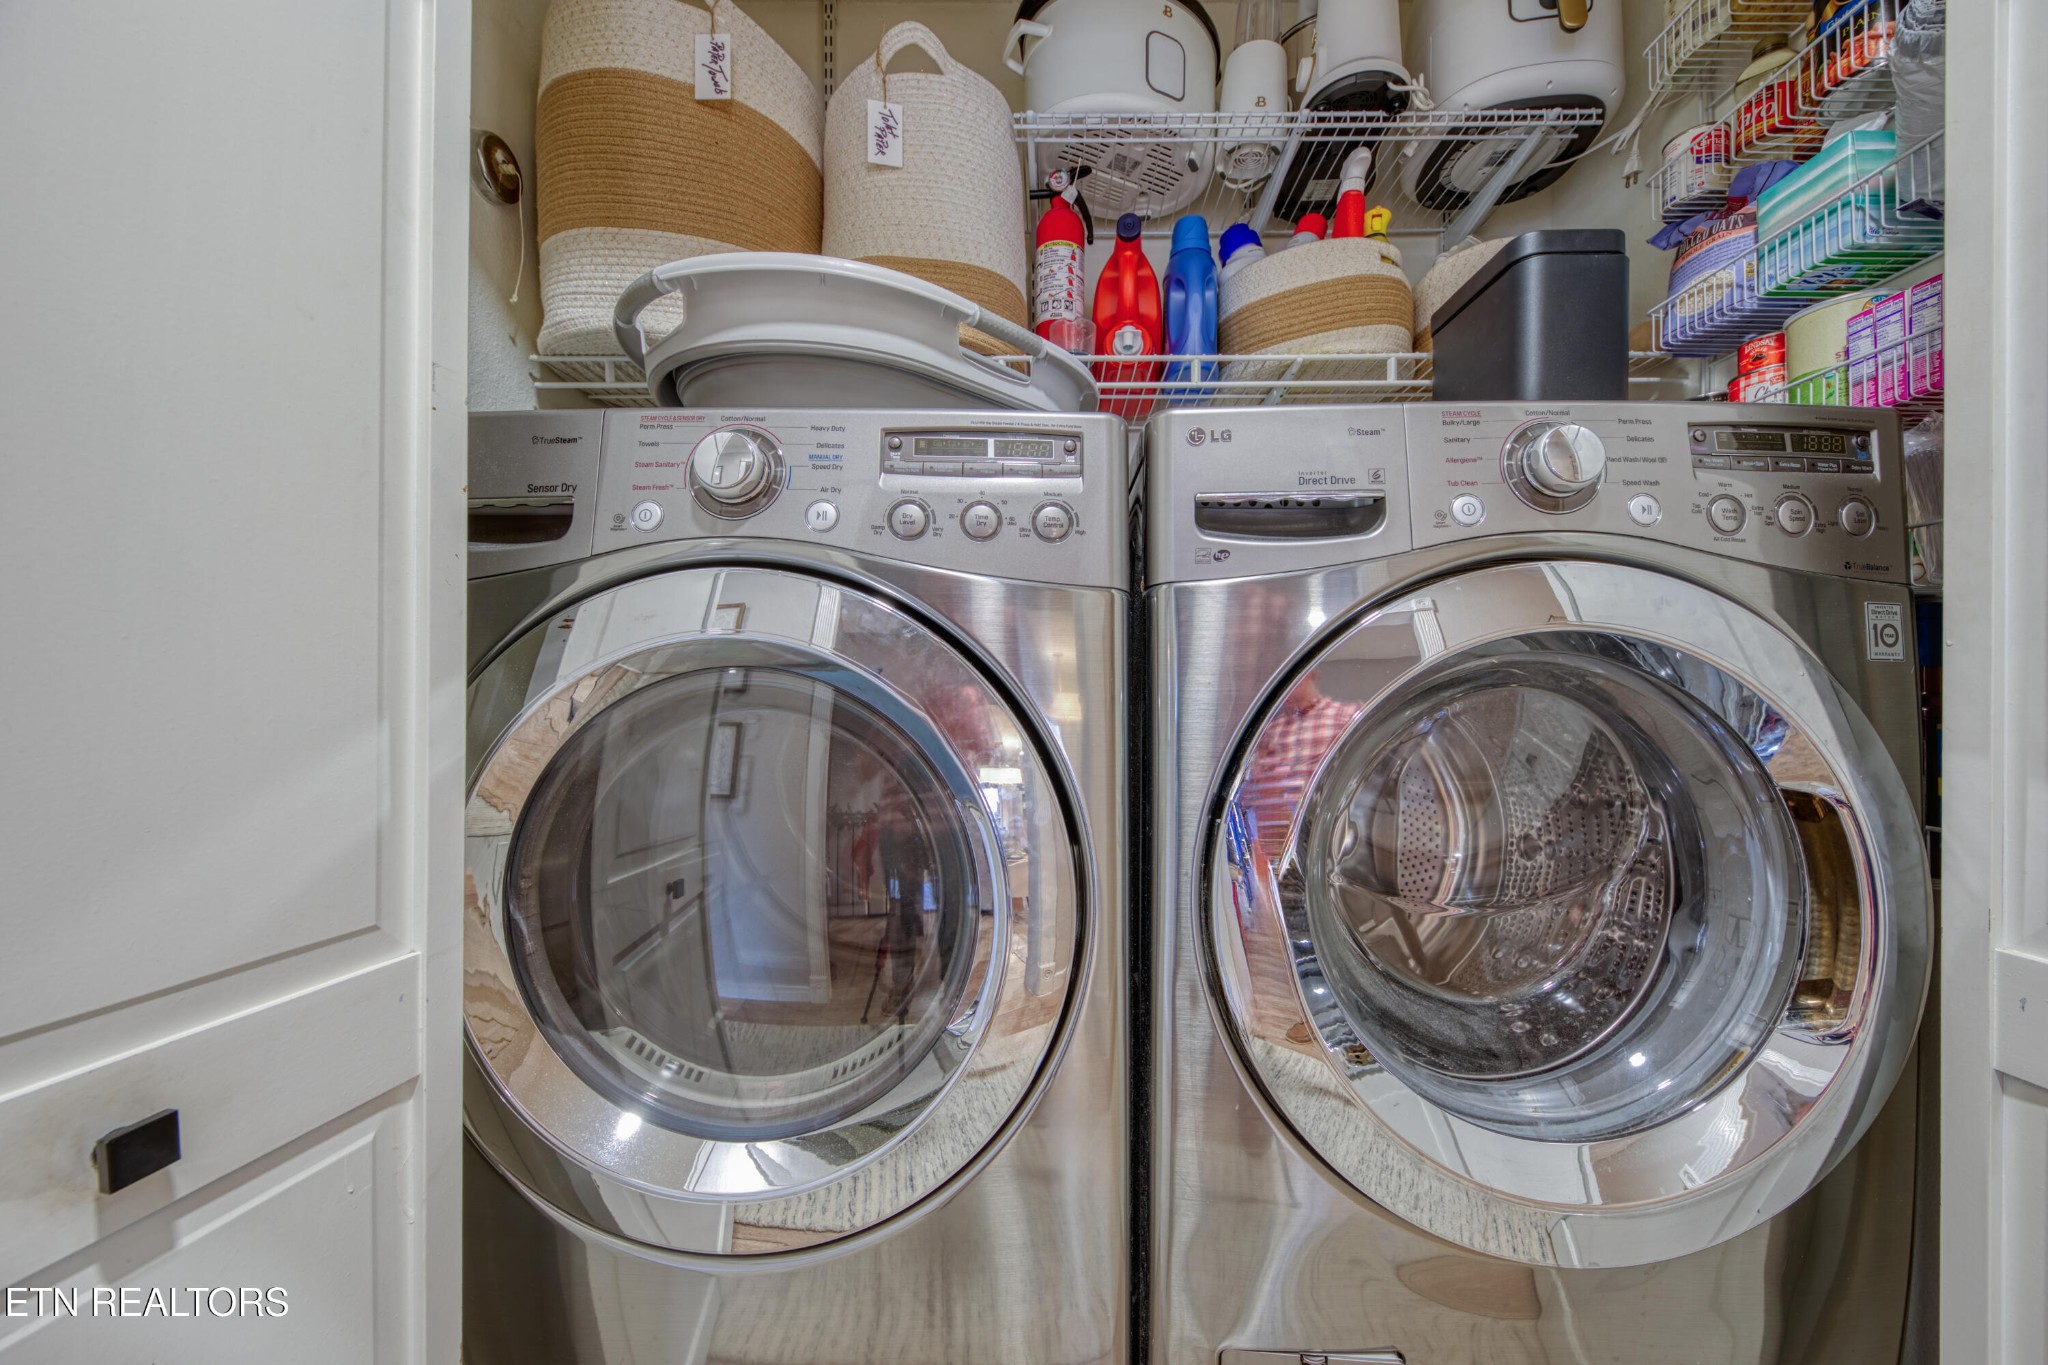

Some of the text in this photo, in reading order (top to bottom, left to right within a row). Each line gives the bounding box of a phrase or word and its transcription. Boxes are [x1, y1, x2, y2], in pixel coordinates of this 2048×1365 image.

[1712, 214, 1744, 233] OATS
[1745, 338, 1774, 354] LINDSAY
[1210, 429, 1232, 442] LG
[1298, 476, 1356, 486] Direct Drive
[527, 483, 578, 494] Sensor Dry
[1873, 623, 1899, 648] 10
